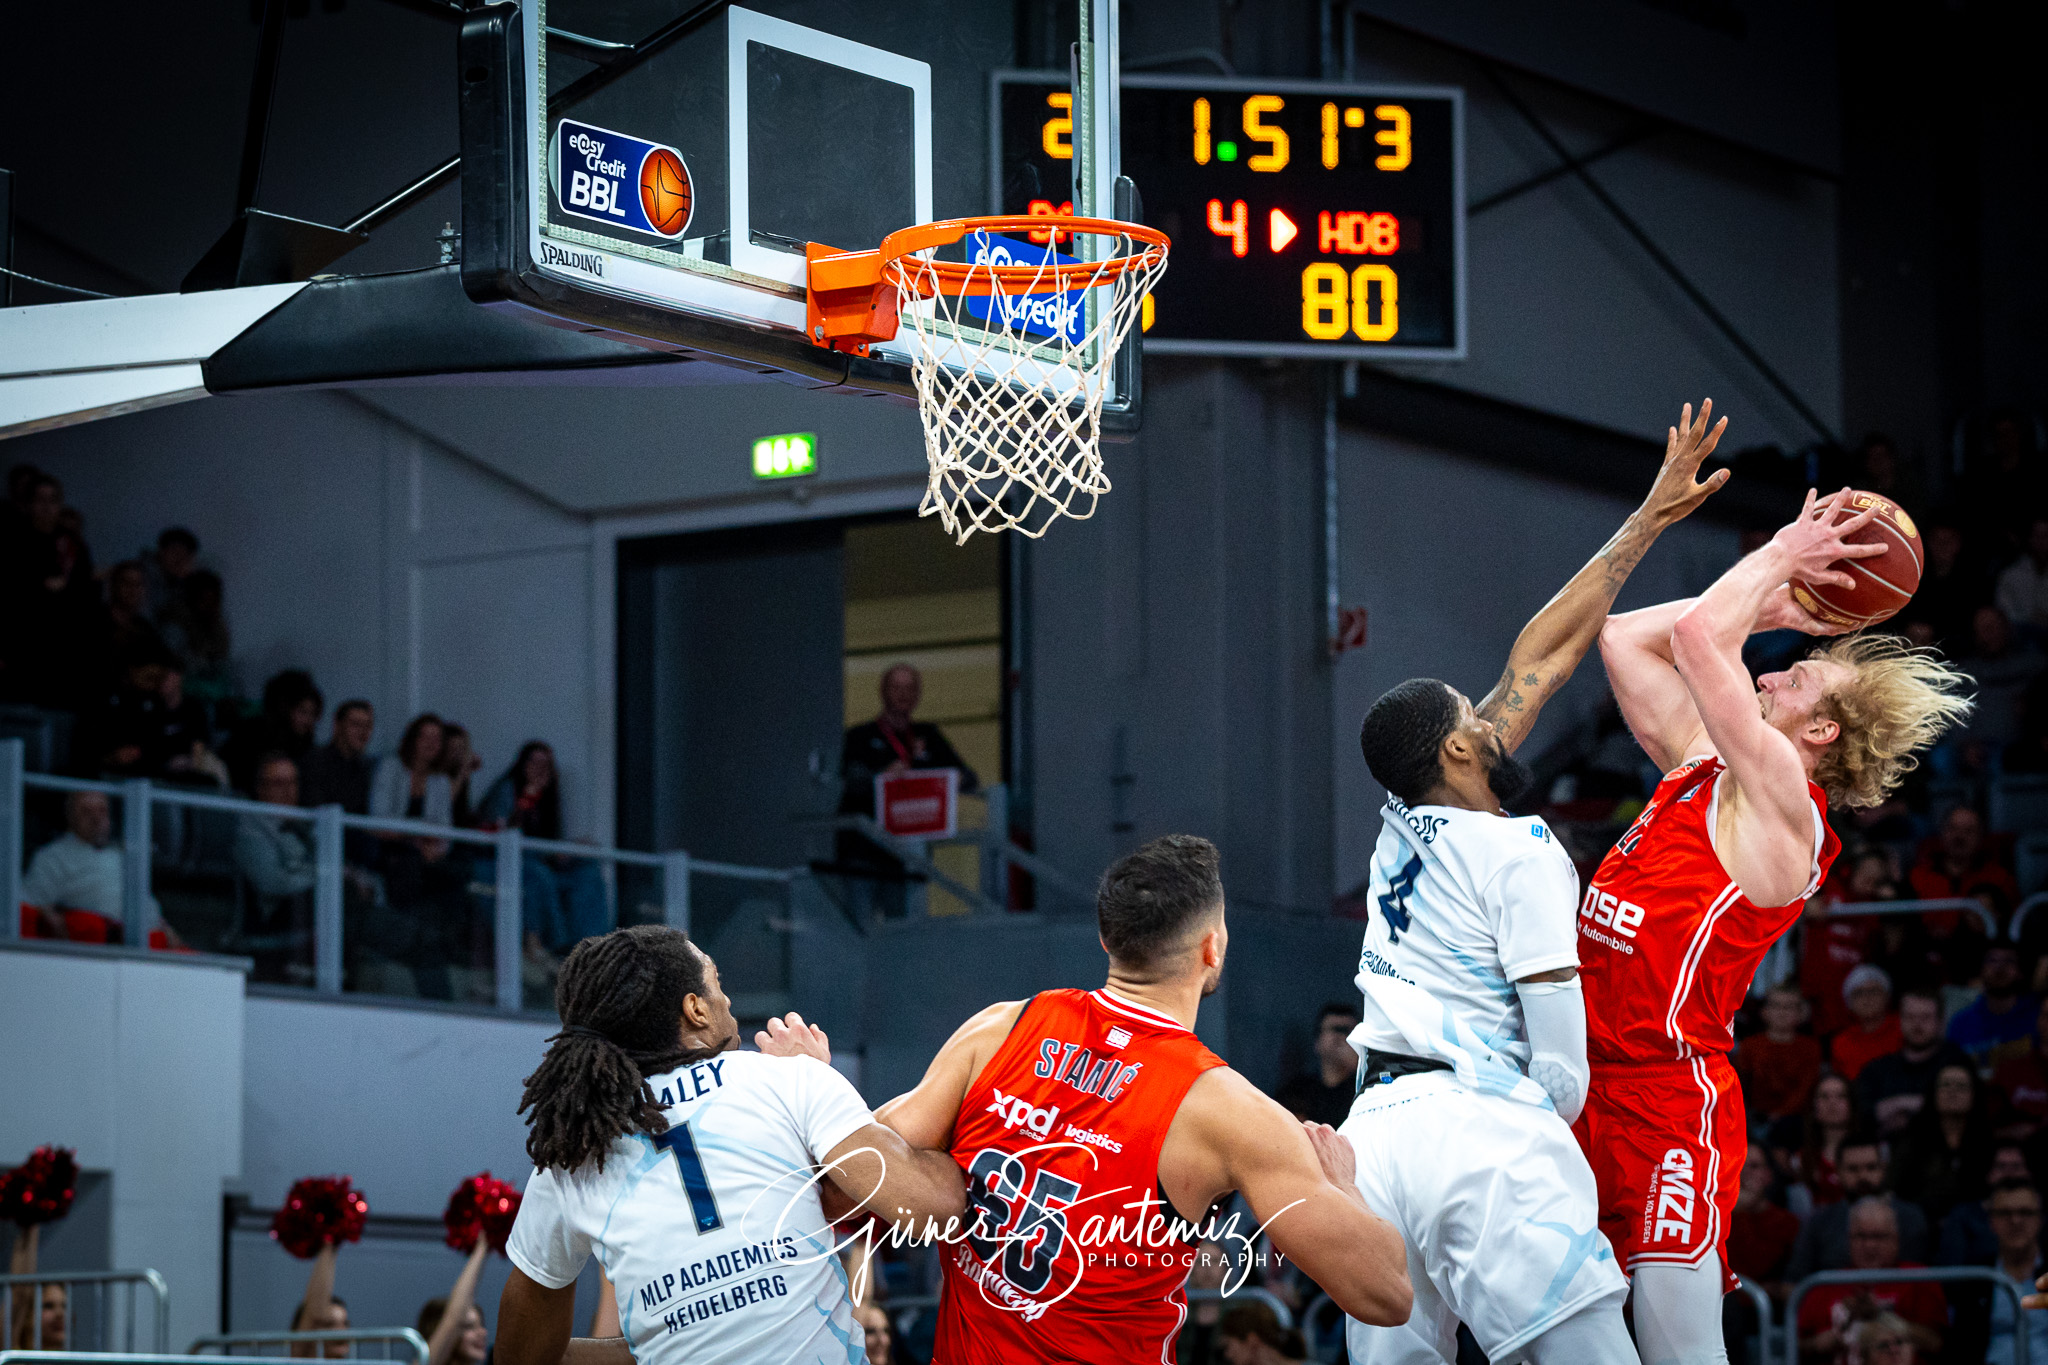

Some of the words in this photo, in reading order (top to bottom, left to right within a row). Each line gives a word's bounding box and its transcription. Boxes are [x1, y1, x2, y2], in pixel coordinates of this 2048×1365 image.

[569, 170, 626, 217] BBL
[586, 152, 626, 179] Credit
[540, 241, 604, 278] SPALDING
[1302, 262, 1399, 342] 80
[1377, 853, 1423, 946] 4
[1581, 885, 1645, 938] ose
[1582, 925, 1634, 955] Automobile
[660, 1059, 725, 1106] ALEY
[1034, 1037, 1144, 1104] STANIĆ
[985, 1087, 1060, 1137] xpd
[1064, 1123, 1123, 1154] logistics
[1018, 1127, 1046, 1142] global
[652, 1119, 725, 1236] 1
[640, 1272, 676, 1312] MLP
[680, 1236, 799, 1292] ACADEMICS
[663, 1274, 788, 1335] HEIDELBERG
